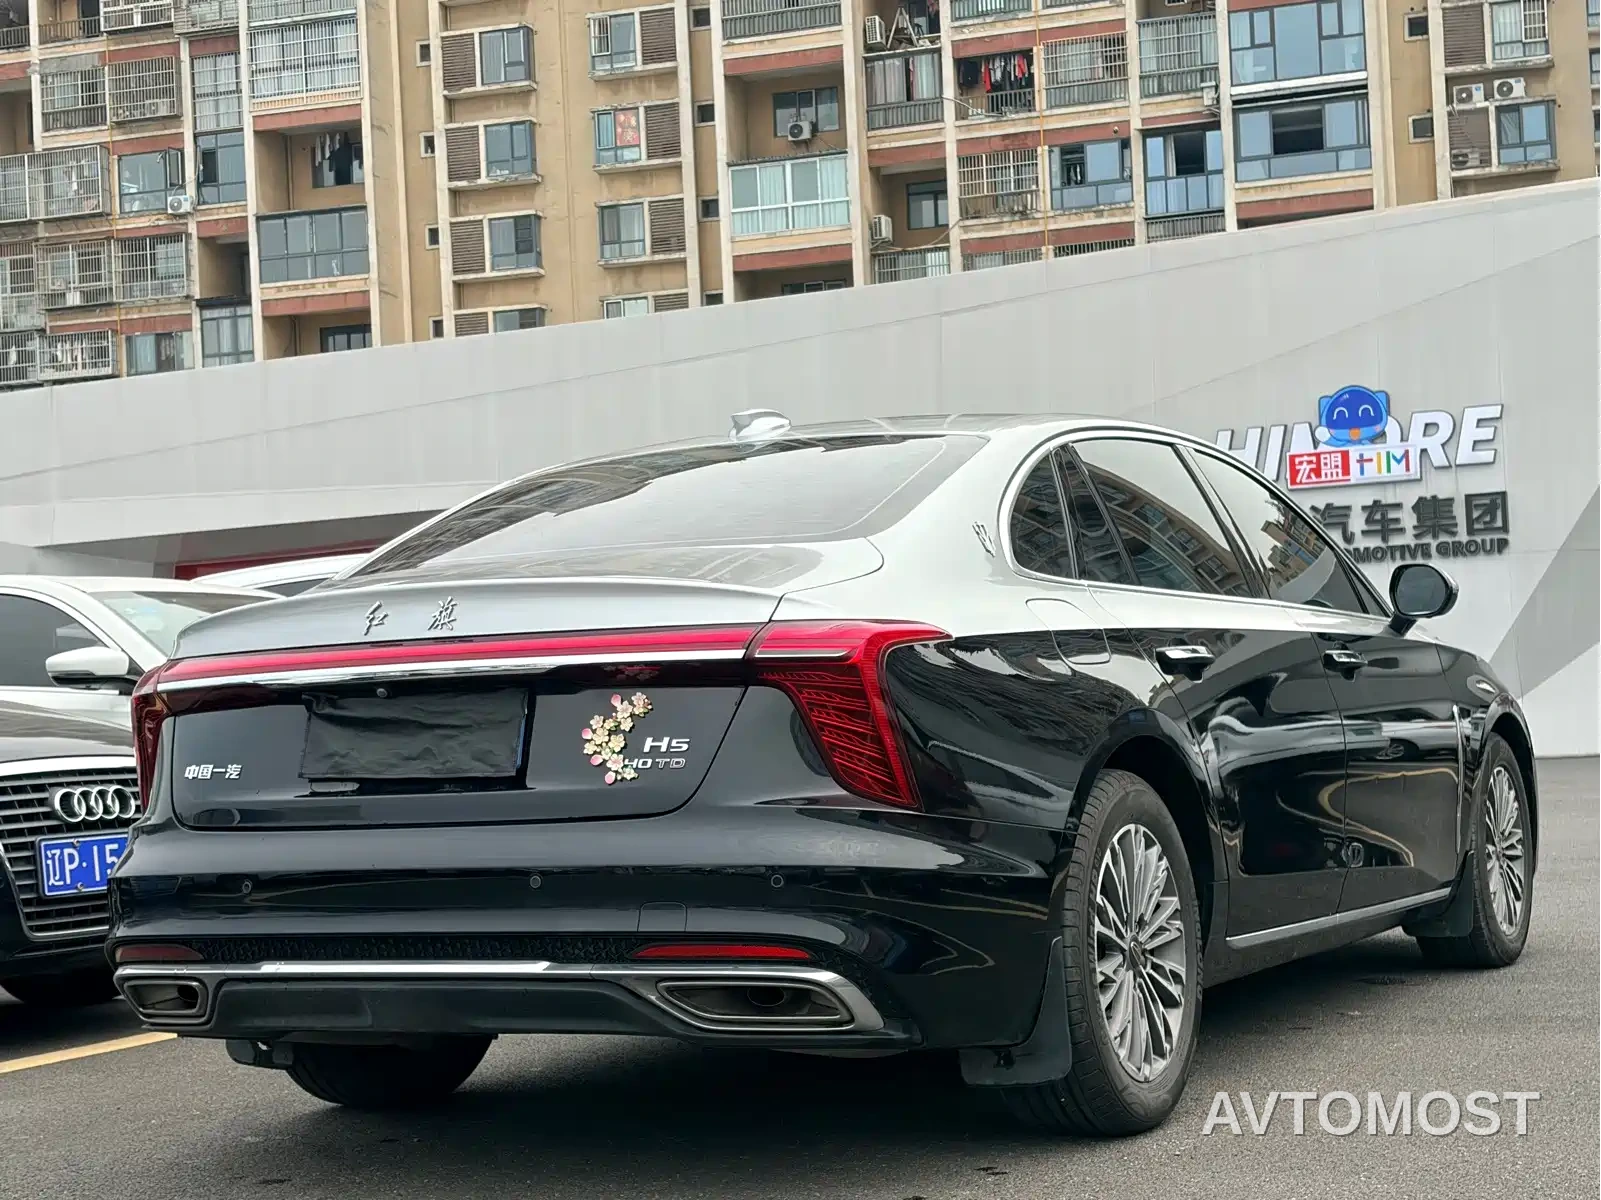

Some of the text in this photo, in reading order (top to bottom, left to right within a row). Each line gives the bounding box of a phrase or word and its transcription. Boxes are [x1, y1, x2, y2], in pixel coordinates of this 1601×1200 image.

[1294, 453, 1351, 484] 宏盟
[1309, 490, 1510, 545] 汽车集团
[1435, 537, 1510, 559] GROUP
[363, 595, 458, 637] 红旗
[643, 736, 690, 753] H5
[184, 763, 243, 780] 中国一汽
